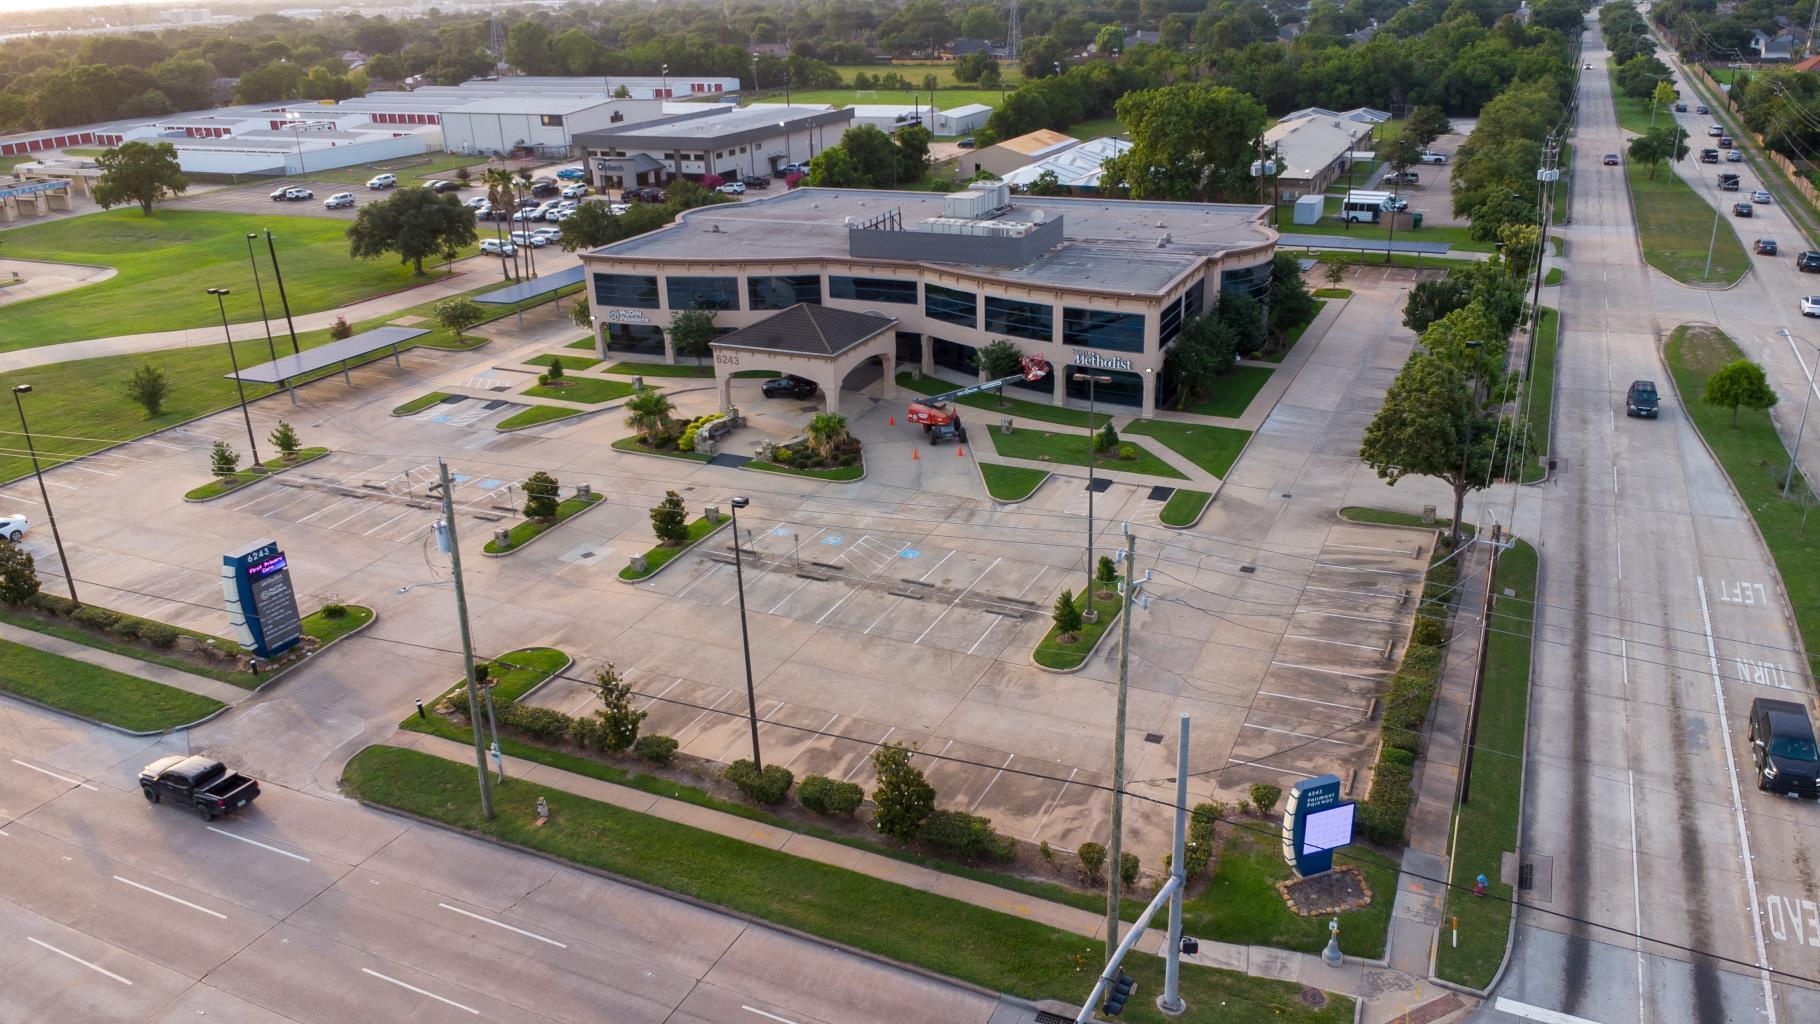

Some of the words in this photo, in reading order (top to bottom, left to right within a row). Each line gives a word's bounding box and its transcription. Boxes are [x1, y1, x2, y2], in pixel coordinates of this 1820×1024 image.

[716, 355, 740, 365] 6243
[1072, 354, 1132, 370] Methodist
[247, 547, 270, 563] 6243
[249, 565, 263, 575] First
[1720, 580, 1767, 606] LEFT
[1736, 658, 1792, 689] TURN
[1307, 792, 1335, 803] Fairmont
[1308, 789, 1323, 797] 6243
[1306, 798, 1334, 808] Parkway
